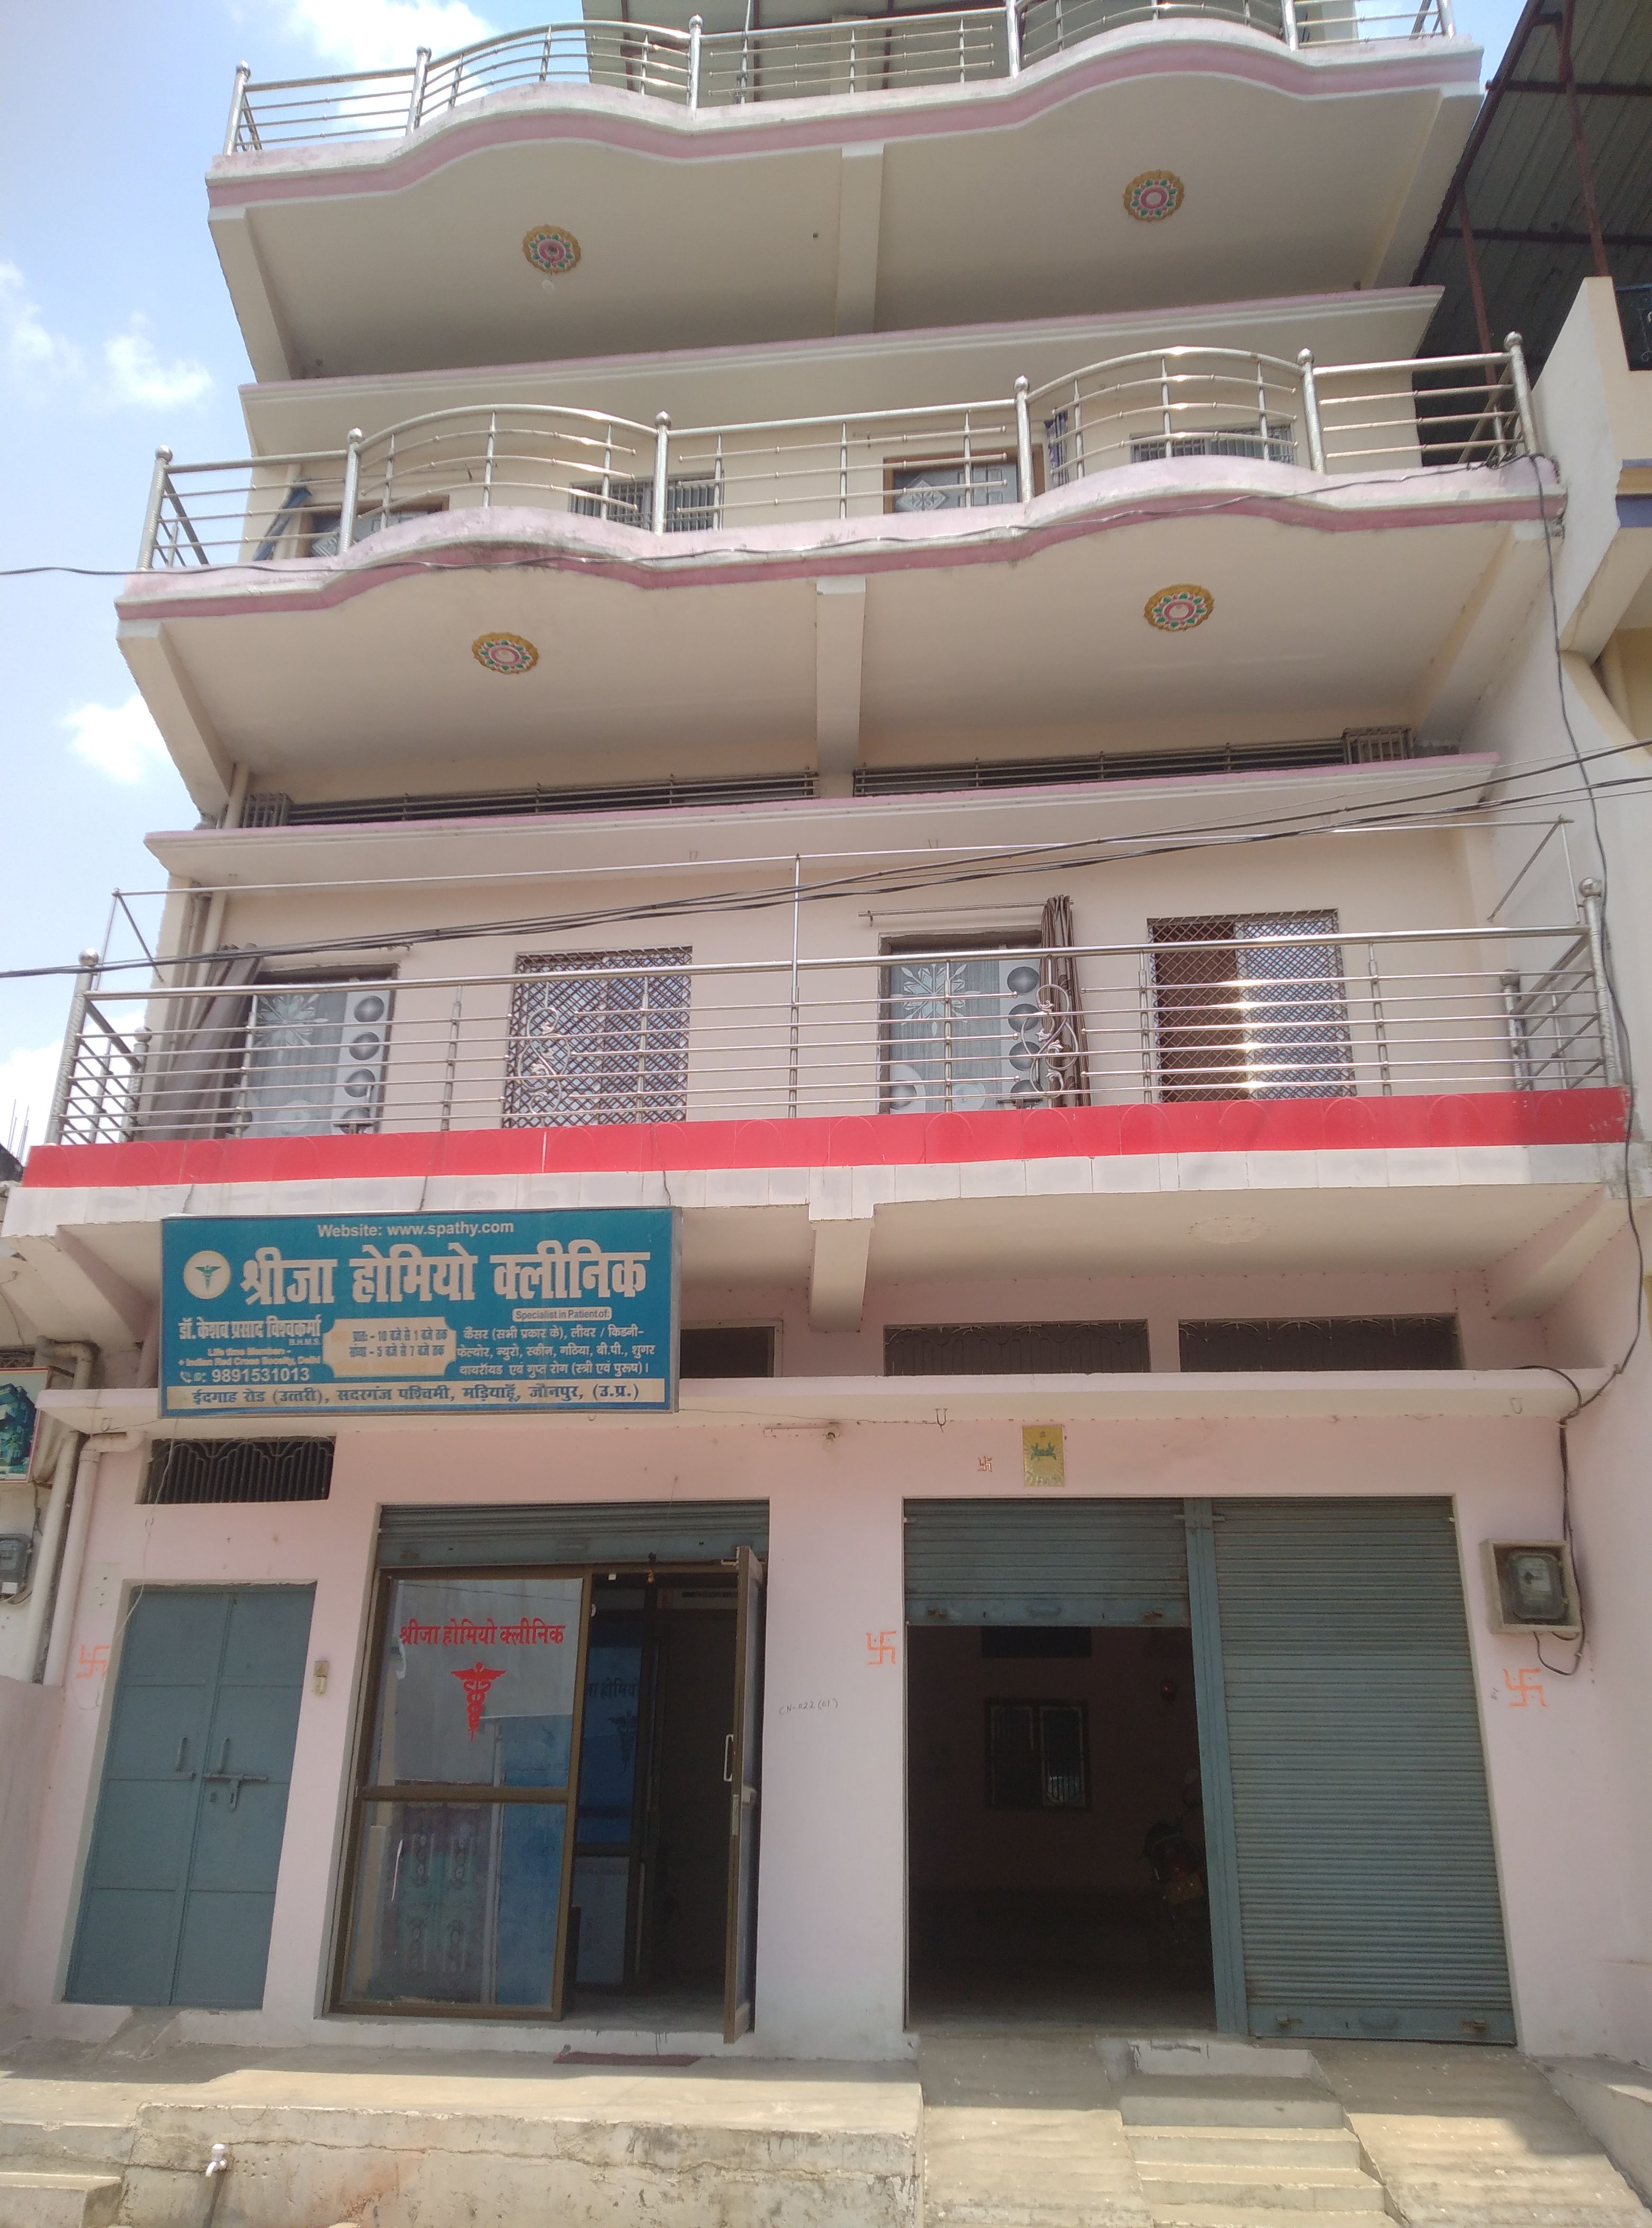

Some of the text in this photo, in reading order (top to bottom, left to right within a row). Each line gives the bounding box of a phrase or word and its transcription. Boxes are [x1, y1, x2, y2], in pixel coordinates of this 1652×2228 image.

[317, 1221, 515, 1237] Website: www.spathy.com
[240, 1239, 651, 1305] श्रीजा होमियो क्लीनिक
[516, 1310, 557, 1320] Specialist
[559, 1309, 567, 1318] in
[196, 1316, 230, 1339] केशव
[231, 1320, 264, 1339] प्रसाद
[492, 1325, 518, 1341] (सभी
[520, 1328, 547, 1339] प्रकार
[570, 1324, 597, 1338] लीवर
[631, 1344, 656, 1359] शुगर
[212, 1367, 311, 1383] 9891531013
[509, 1362, 524, 1376] एवं
[526, 1363, 547, 1378] गुप्त
[549, 1360, 569, 1374] रोग
[596, 1360, 610, 1374] एवं
[191, 1388, 238, 1405] ईदगाह
[243, 1388, 266, 1403] रोड
[592, 1383, 639, 1401] (उ.प्र.)
[398, 1617, 566, 1647] श्रीजा होमियो क्लीनिक
